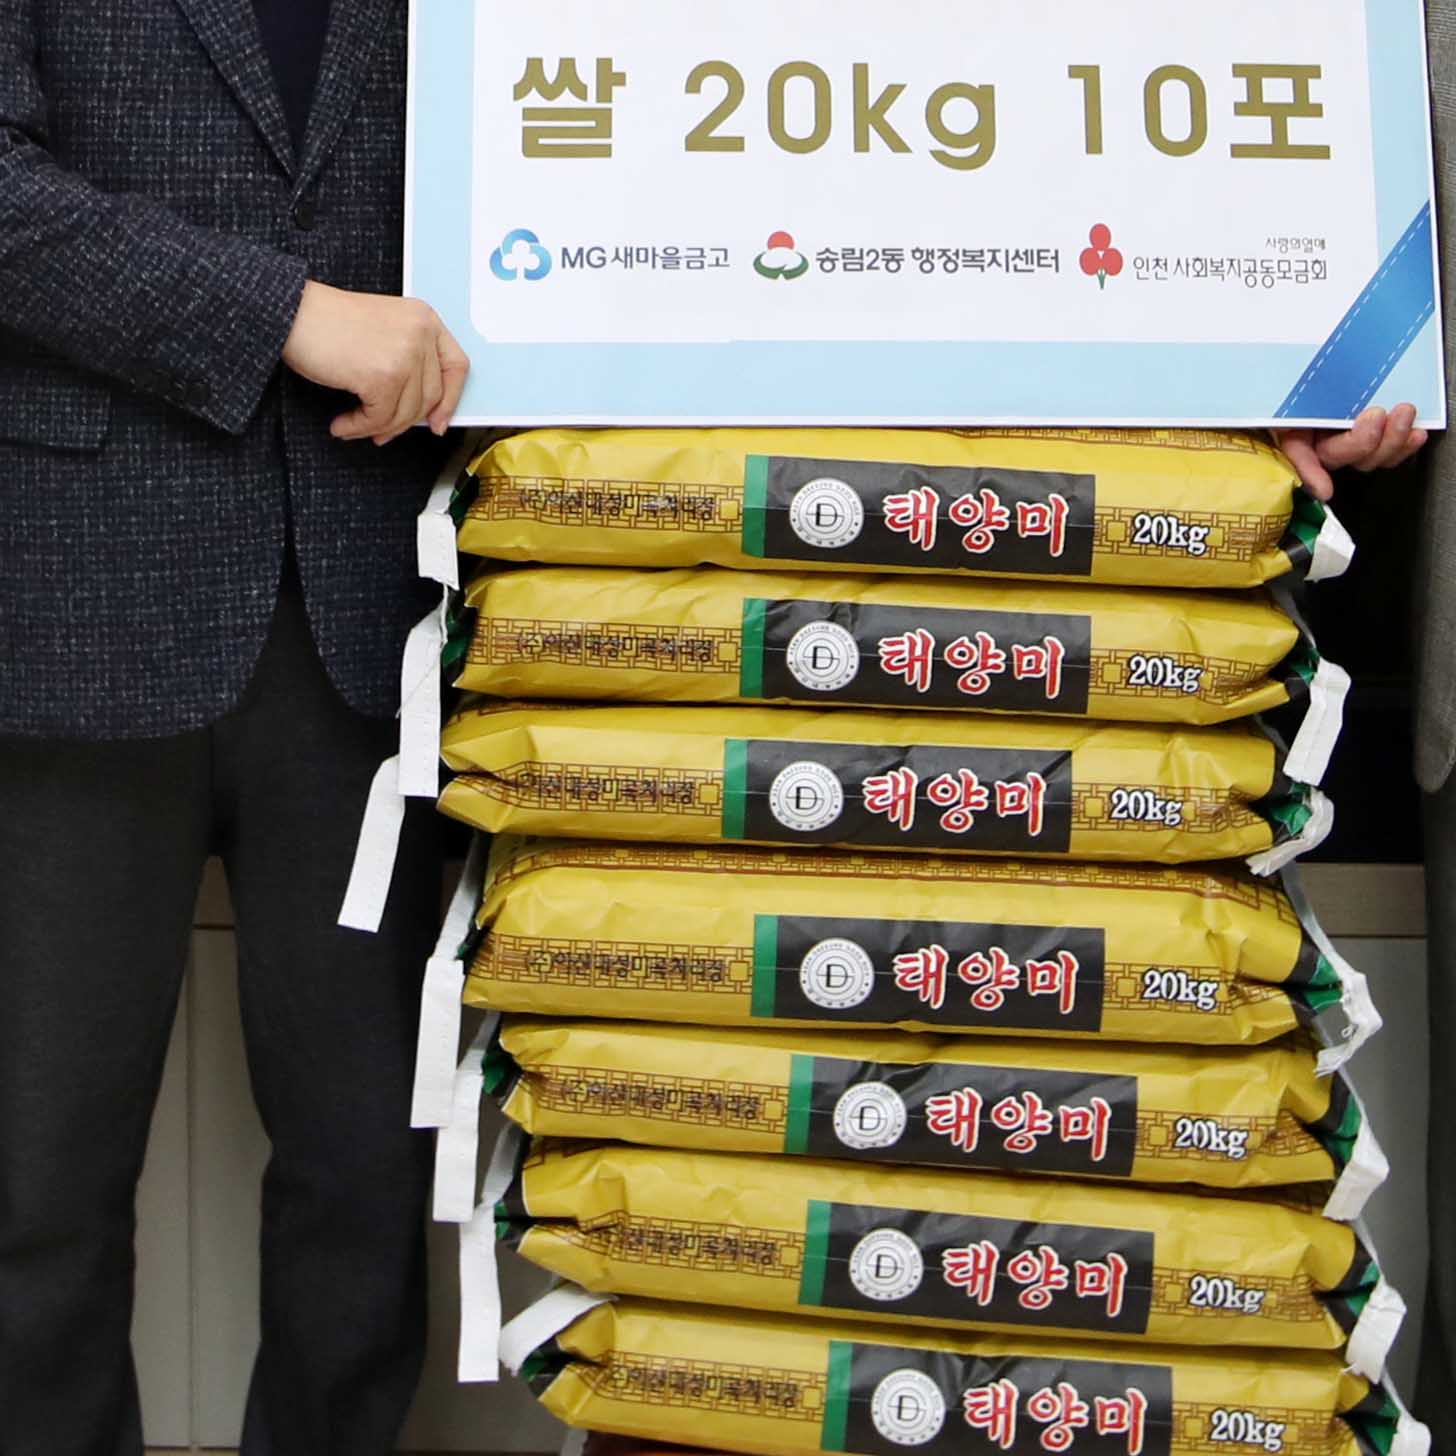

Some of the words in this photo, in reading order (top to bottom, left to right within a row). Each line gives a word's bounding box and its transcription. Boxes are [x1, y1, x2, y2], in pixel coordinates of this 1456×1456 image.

[512, 56, 627, 160] 쌀
[683, 59, 997, 172] 20kg
[1066, 63, 1332, 161] 10포
[815, 247, 904, 275] 송림2동
[910, 247, 1060, 275] 행정복지센터
[882, 486, 1069, 558] 태양미
[1133, 514, 1210, 556] 20kg
[878, 628, 1064, 701] 태양미
[1128, 654, 1201, 694] 20kg
[862, 766, 1045, 837] 태양미
[1110, 789, 1183, 826] 20kg
[893, 944, 1078, 1016] 태양미
[1143, 969, 1219, 1010] 20kg
[925, 1086, 1111, 1162] 태양미
[1175, 1118, 1248, 1160] 20kg
[942, 1239, 1128, 1317] 태양미
[1189, 1278, 1264, 1314] 20kg
[963, 1378, 1149, 1456] 태양미
[1210, 1410, 1286, 1451] 20kg
